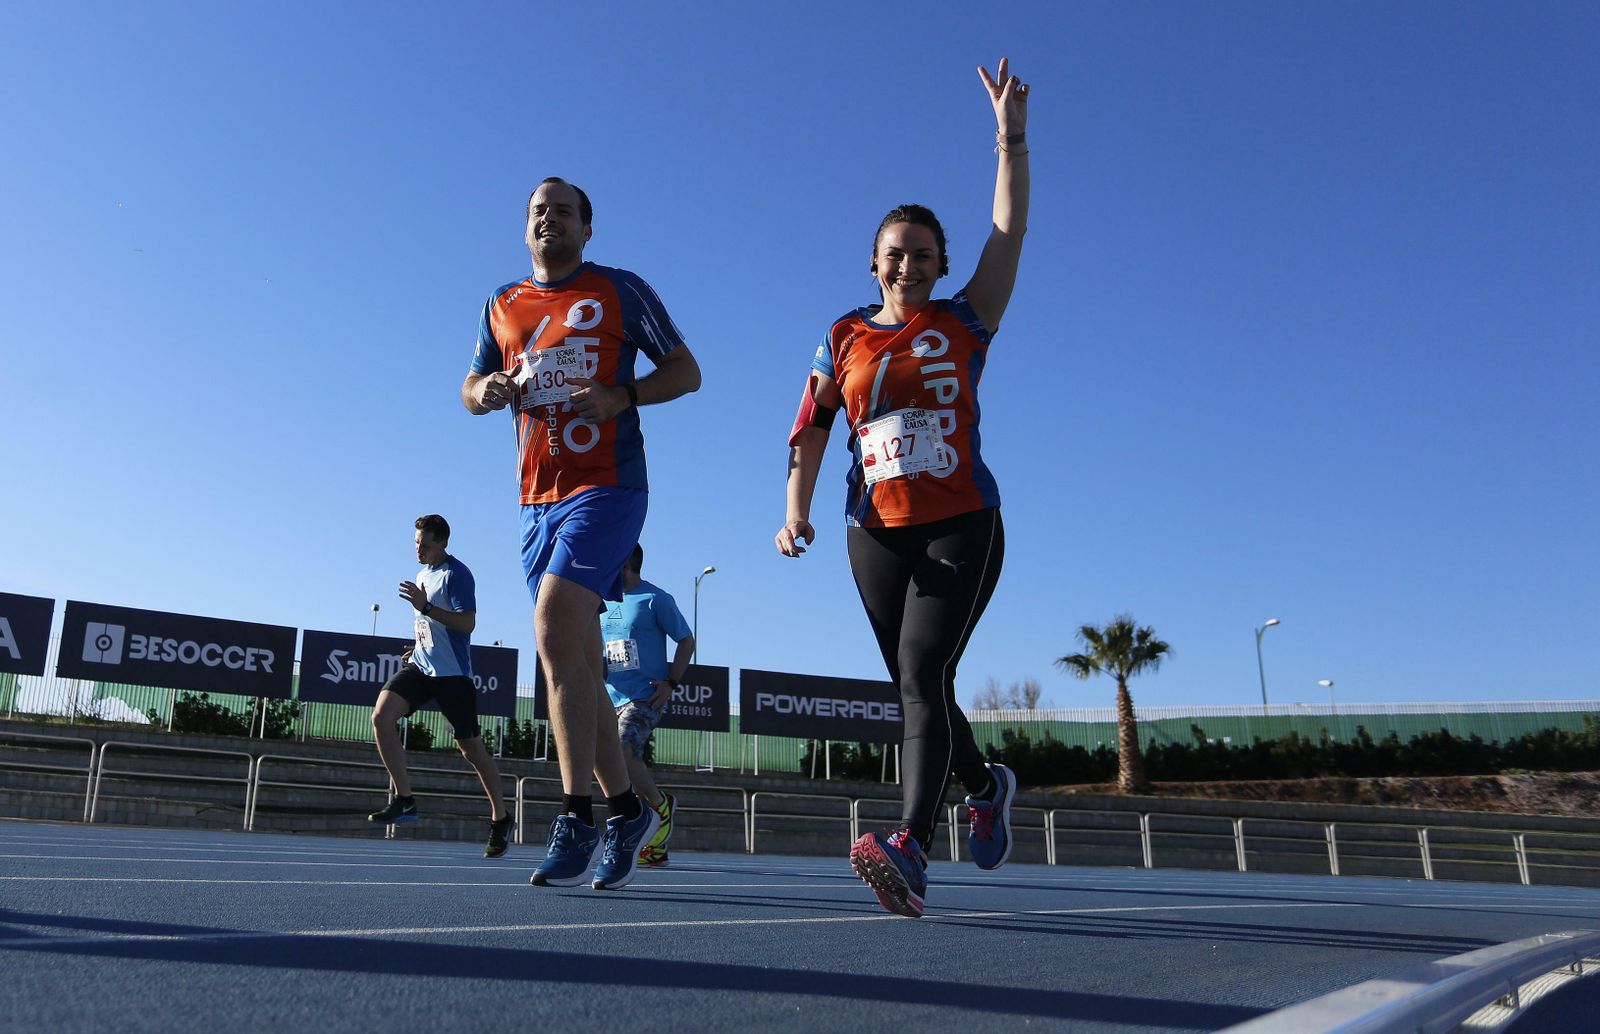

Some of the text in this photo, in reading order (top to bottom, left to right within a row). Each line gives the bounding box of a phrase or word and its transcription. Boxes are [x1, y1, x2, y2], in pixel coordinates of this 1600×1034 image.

[532, 369, 565, 392] 130
[904, 419, 928, 430] CAUSA
[881, 433, 916, 462] 127
[128, 634, 275, 673] BESOCCER
[671, 684, 713, 704] RUP
[671, 704, 713, 717] SEGUROS
[755, 692, 903, 722] POWERADE
